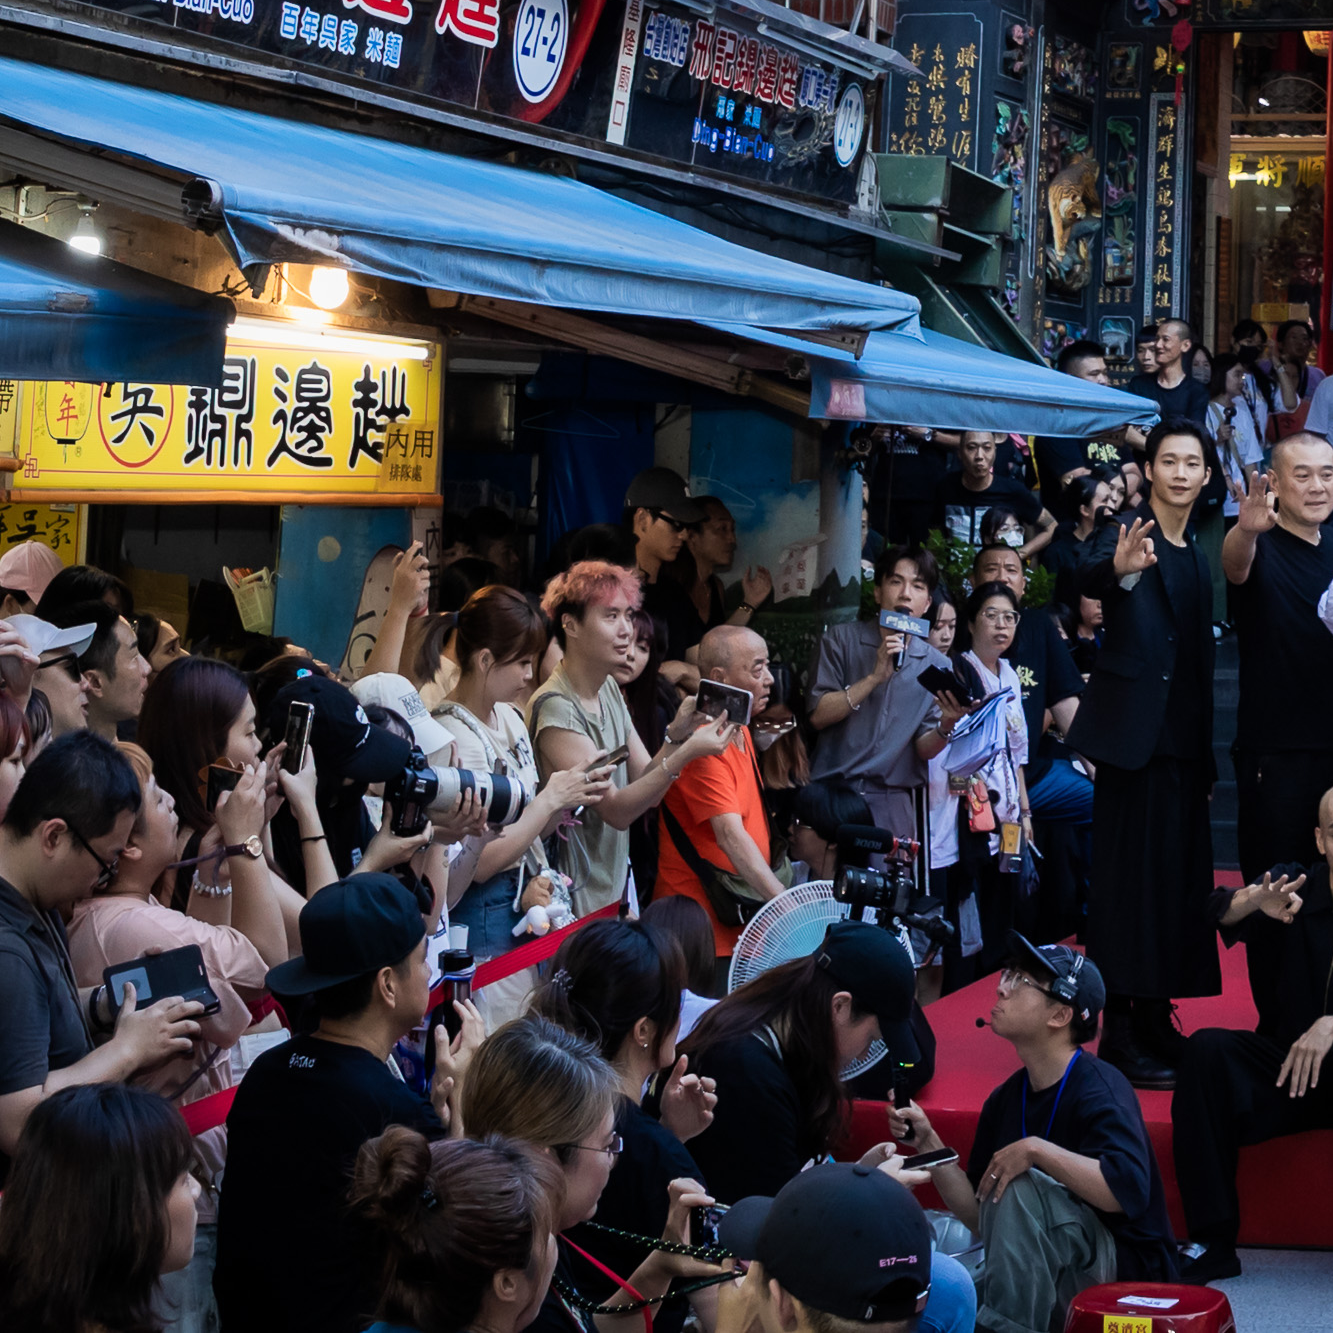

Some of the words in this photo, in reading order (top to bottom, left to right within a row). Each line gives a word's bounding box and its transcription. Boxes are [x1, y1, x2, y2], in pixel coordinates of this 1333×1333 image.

[280, 1, 359, 56] 百年吳家
[519, 3, 562, 64] 27-2
[385, 428, 434, 459] 內用
[389, 463, 422, 482] 排隊處
